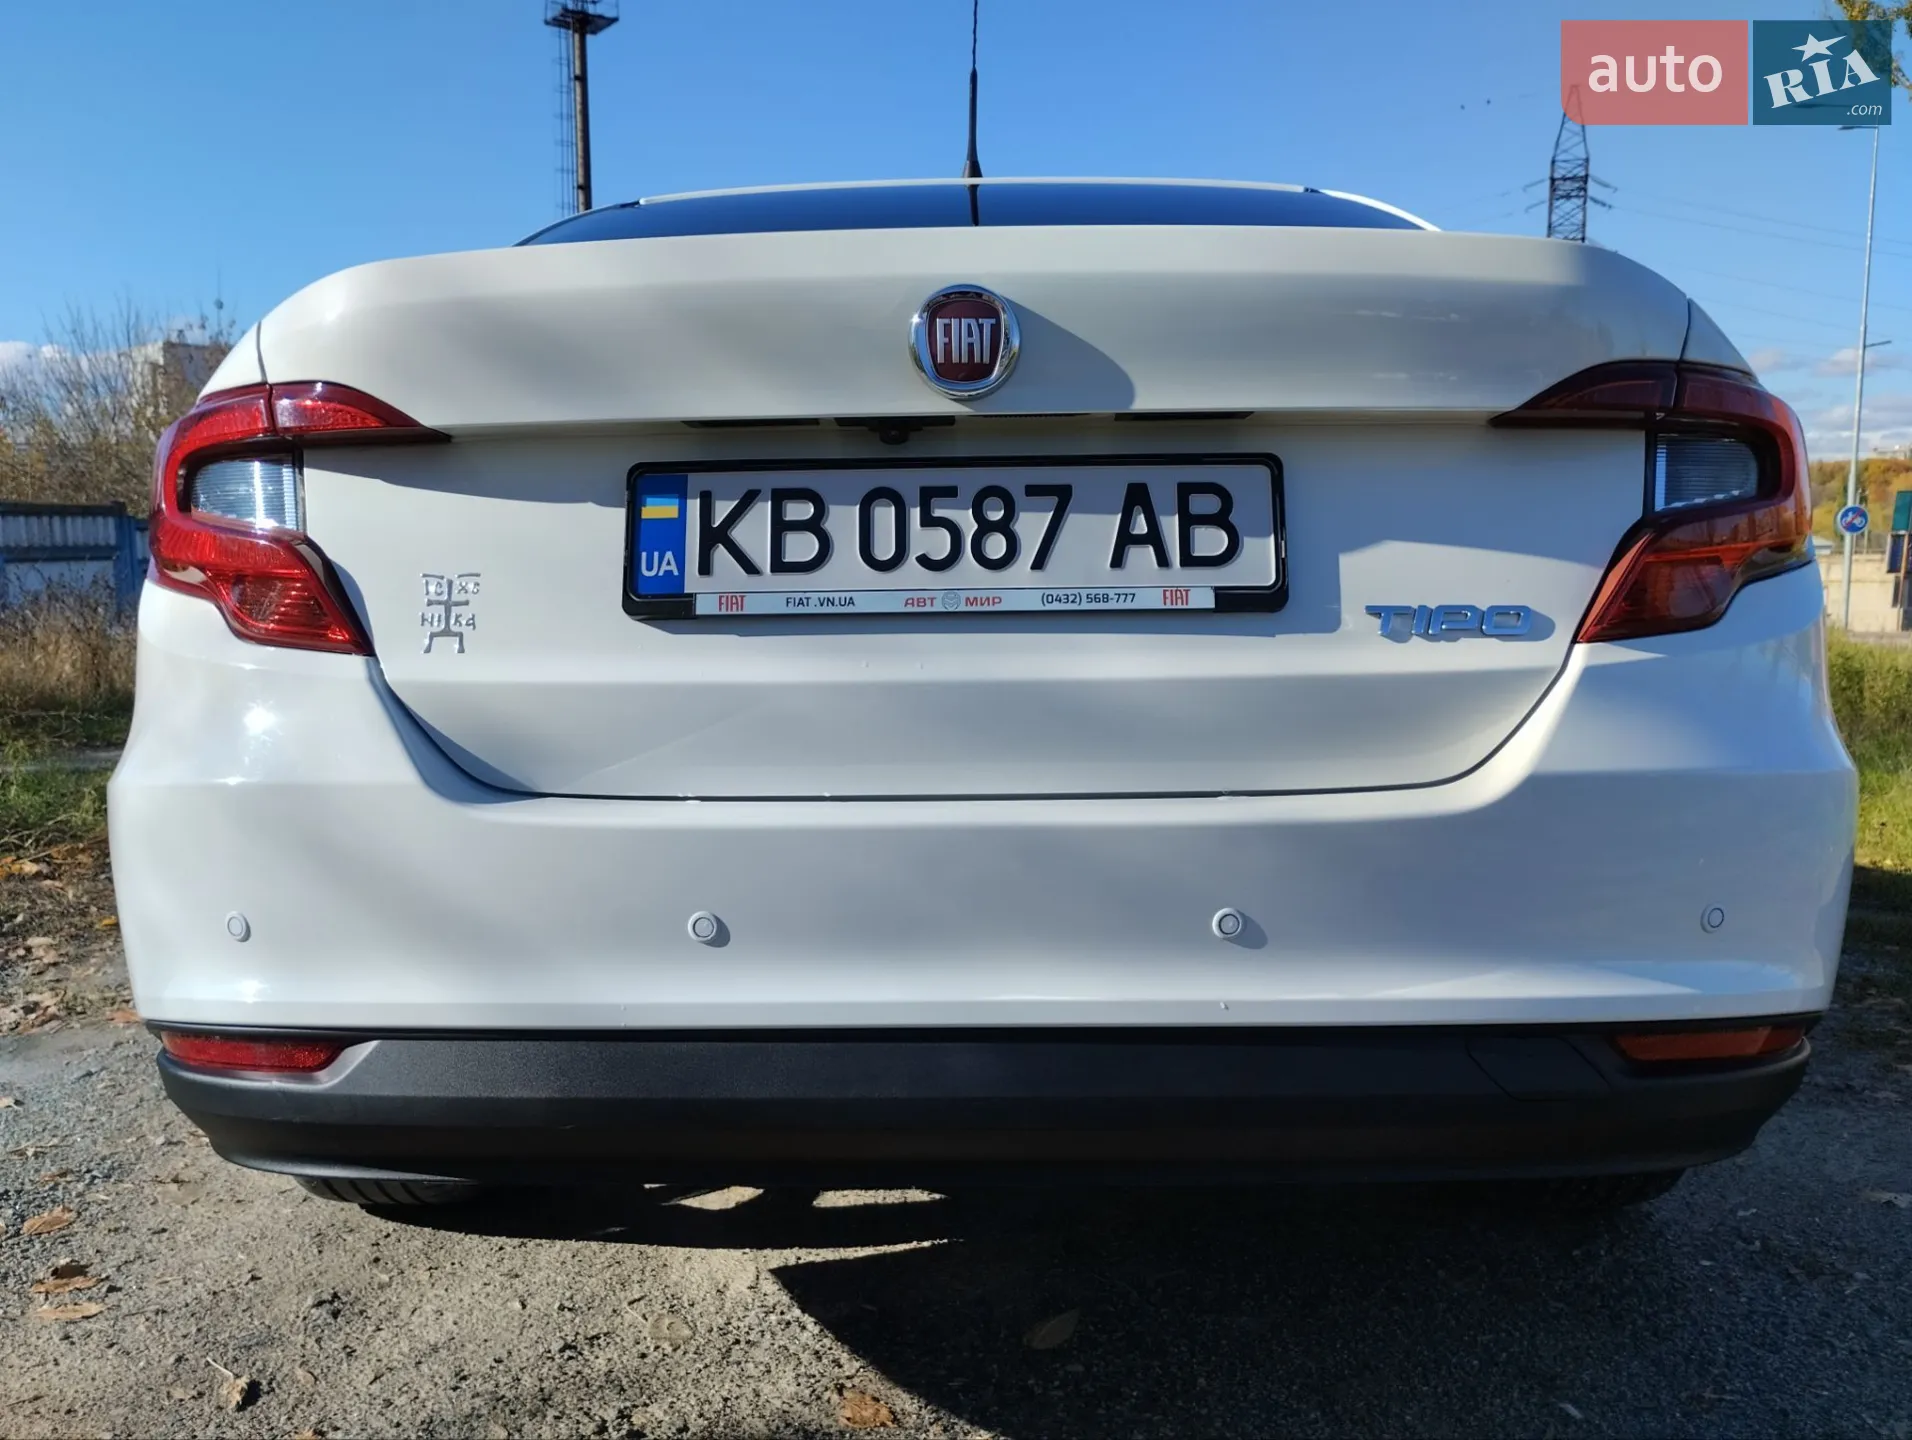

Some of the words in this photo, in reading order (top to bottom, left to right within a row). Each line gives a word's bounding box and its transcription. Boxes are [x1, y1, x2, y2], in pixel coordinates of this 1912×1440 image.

[936, 317, 996, 364] FIAT
[697, 487, 834, 576] KB
[858, 484, 1072, 573] 0587
[1109, 481, 1241, 569] AB
[641, 551, 678, 576] UA
[718, 594, 747, 612] FIAT
[1041, 591, 1083, 605] (0432)
[1085, 592, 1136, 604] 568-777
[1162, 588, 1191, 606] FIAT
[1365, 604, 1533, 635] TIPO
